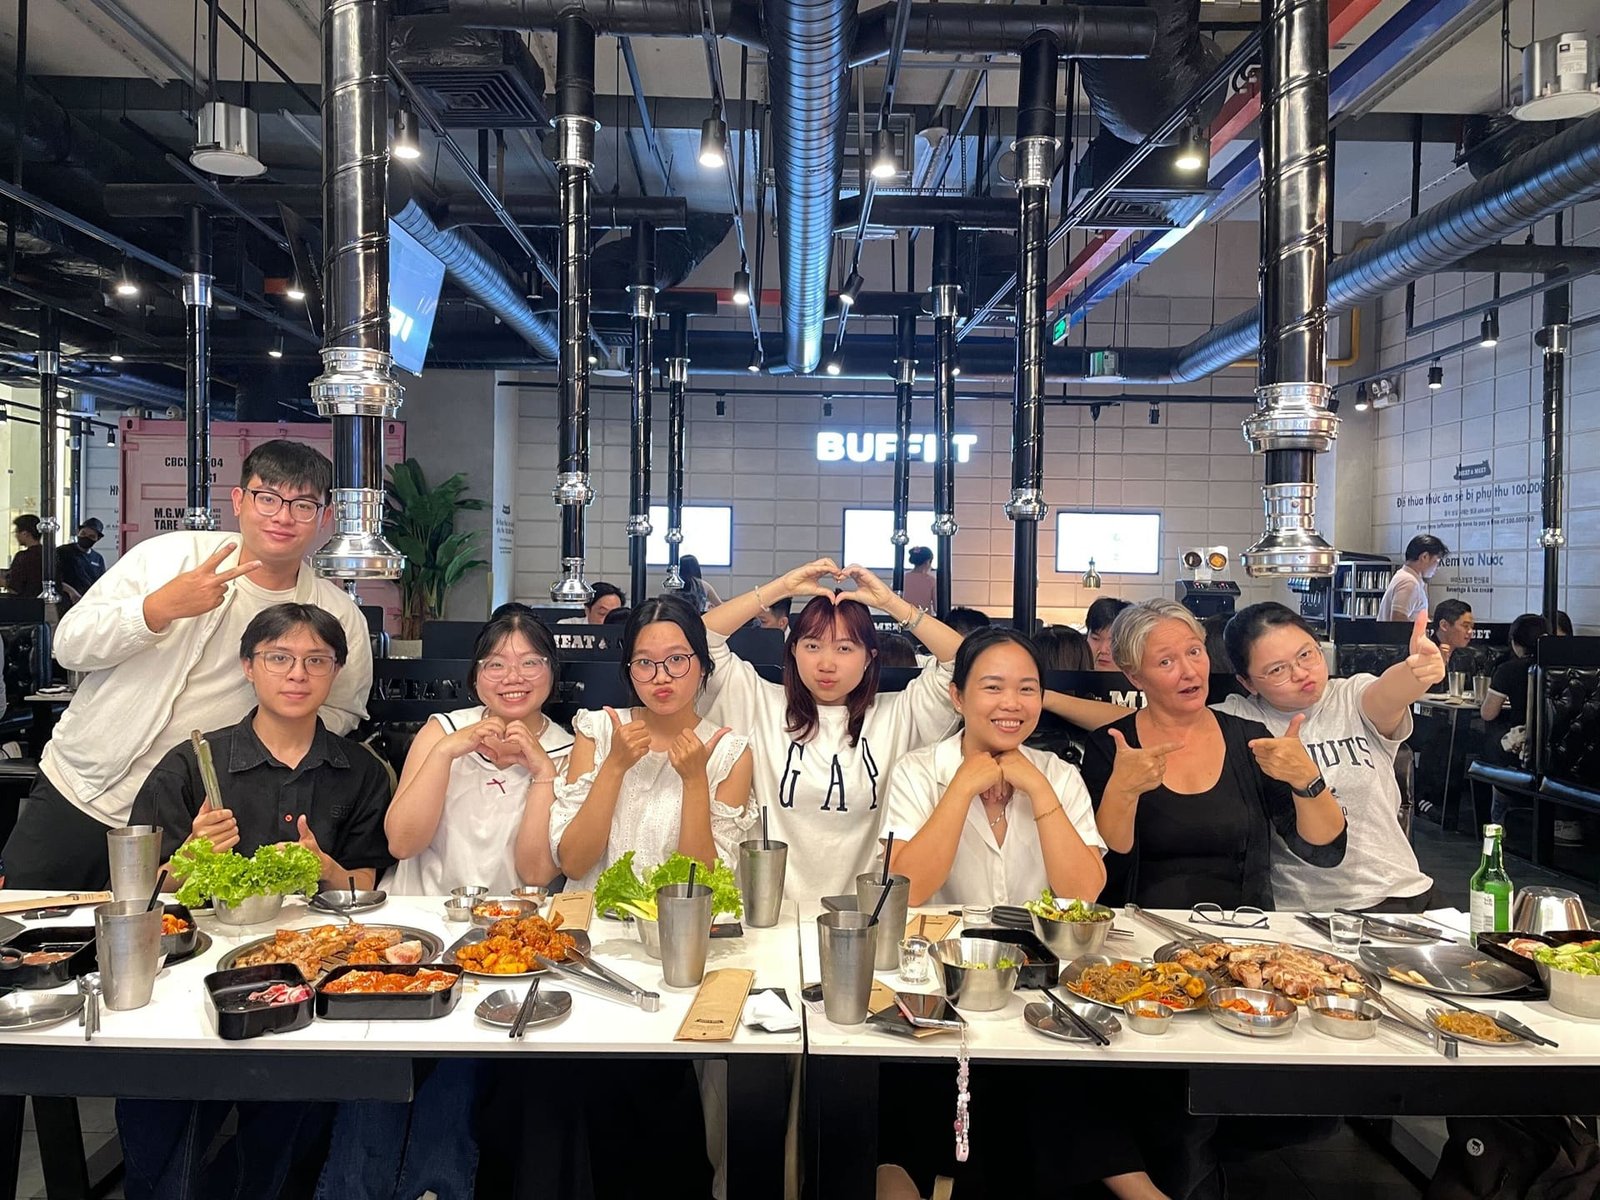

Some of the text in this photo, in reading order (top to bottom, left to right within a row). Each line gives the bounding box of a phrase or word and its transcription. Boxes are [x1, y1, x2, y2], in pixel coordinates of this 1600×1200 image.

[1494, 484, 1509, 497] thu
[154, 519, 179, 530] TARE
[1462, 553, 1474, 566] và
